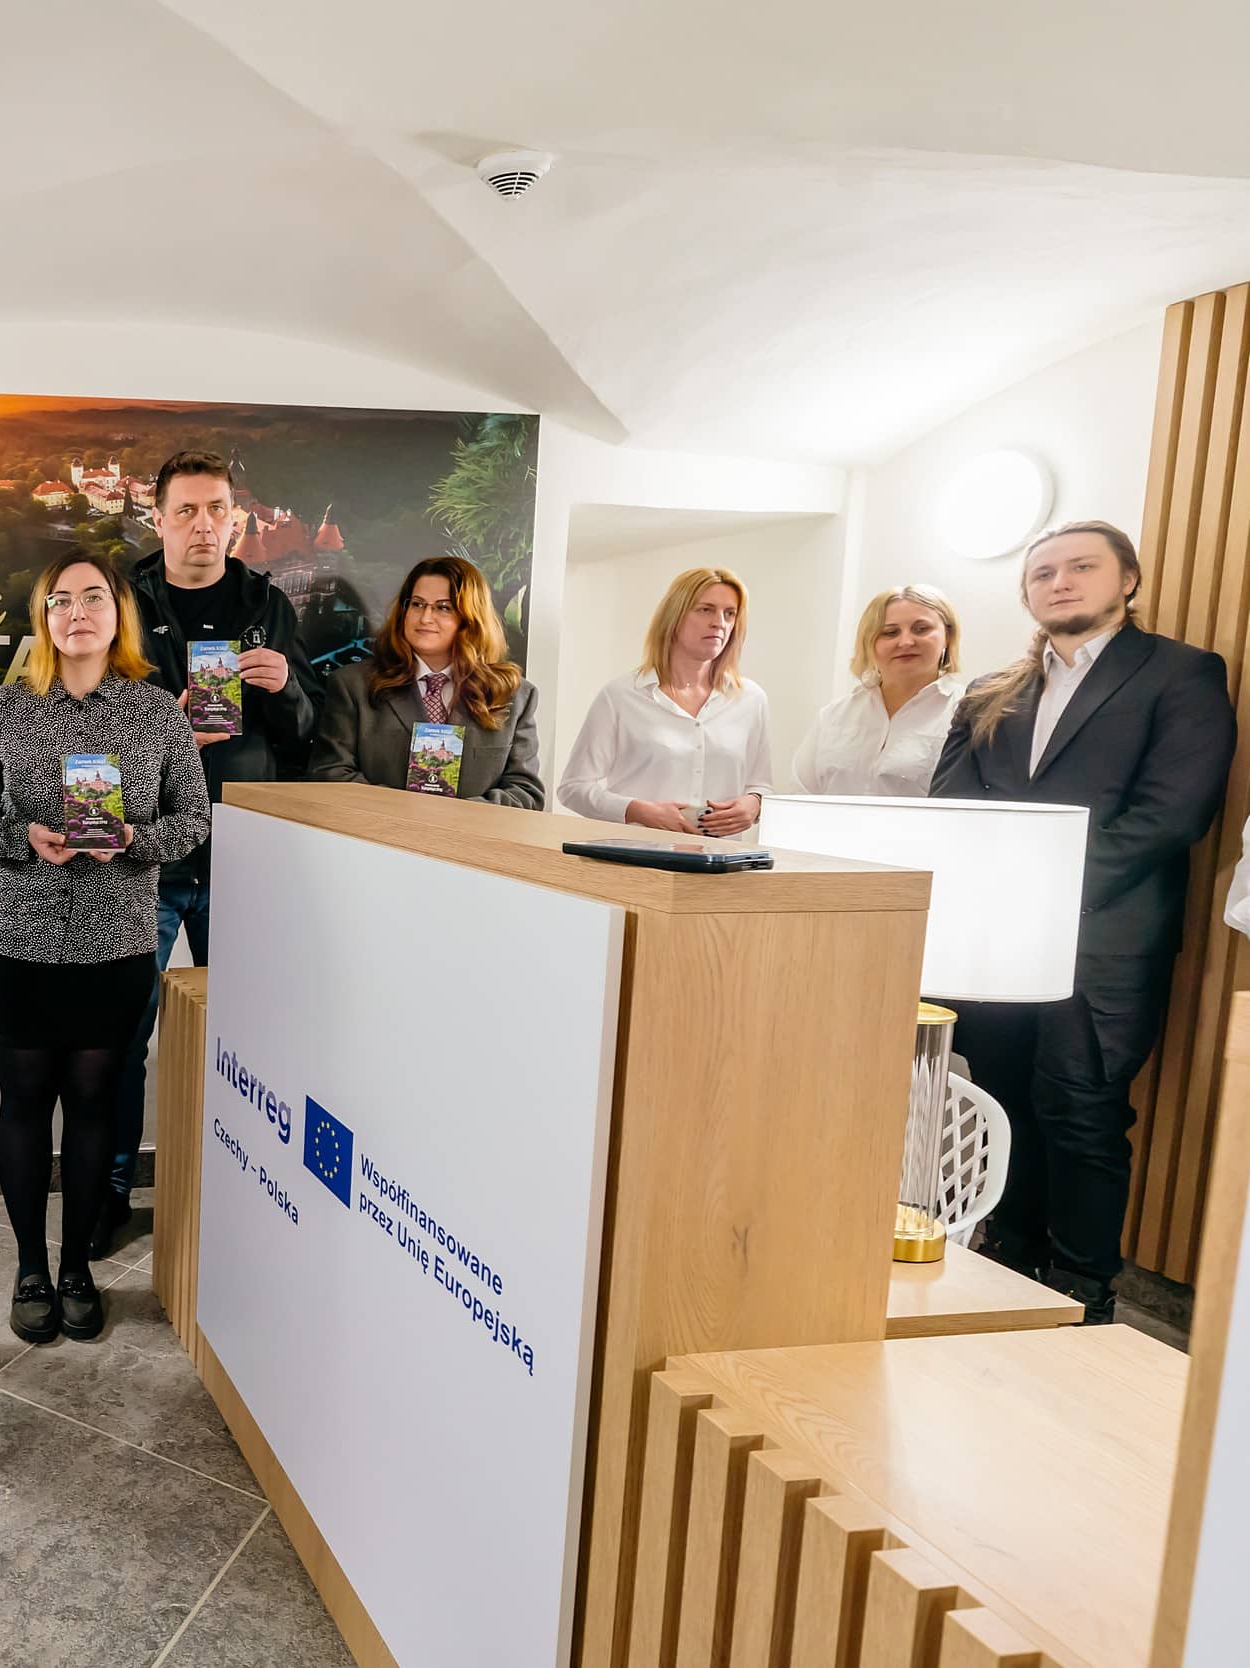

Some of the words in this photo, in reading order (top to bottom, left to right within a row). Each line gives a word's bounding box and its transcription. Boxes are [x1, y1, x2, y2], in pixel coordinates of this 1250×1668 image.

[216, 1037, 292, 1145] Interreg
[213, 1117, 249, 1172] Czechy
[259, 1166, 299, 1226] Polska
[360, 1153, 503, 1295] Współfinansowane
[359, 1191, 393, 1236] przez
[397, 1221, 430, 1274] Unię
[434, 1254, 534, 1377] Europejską
